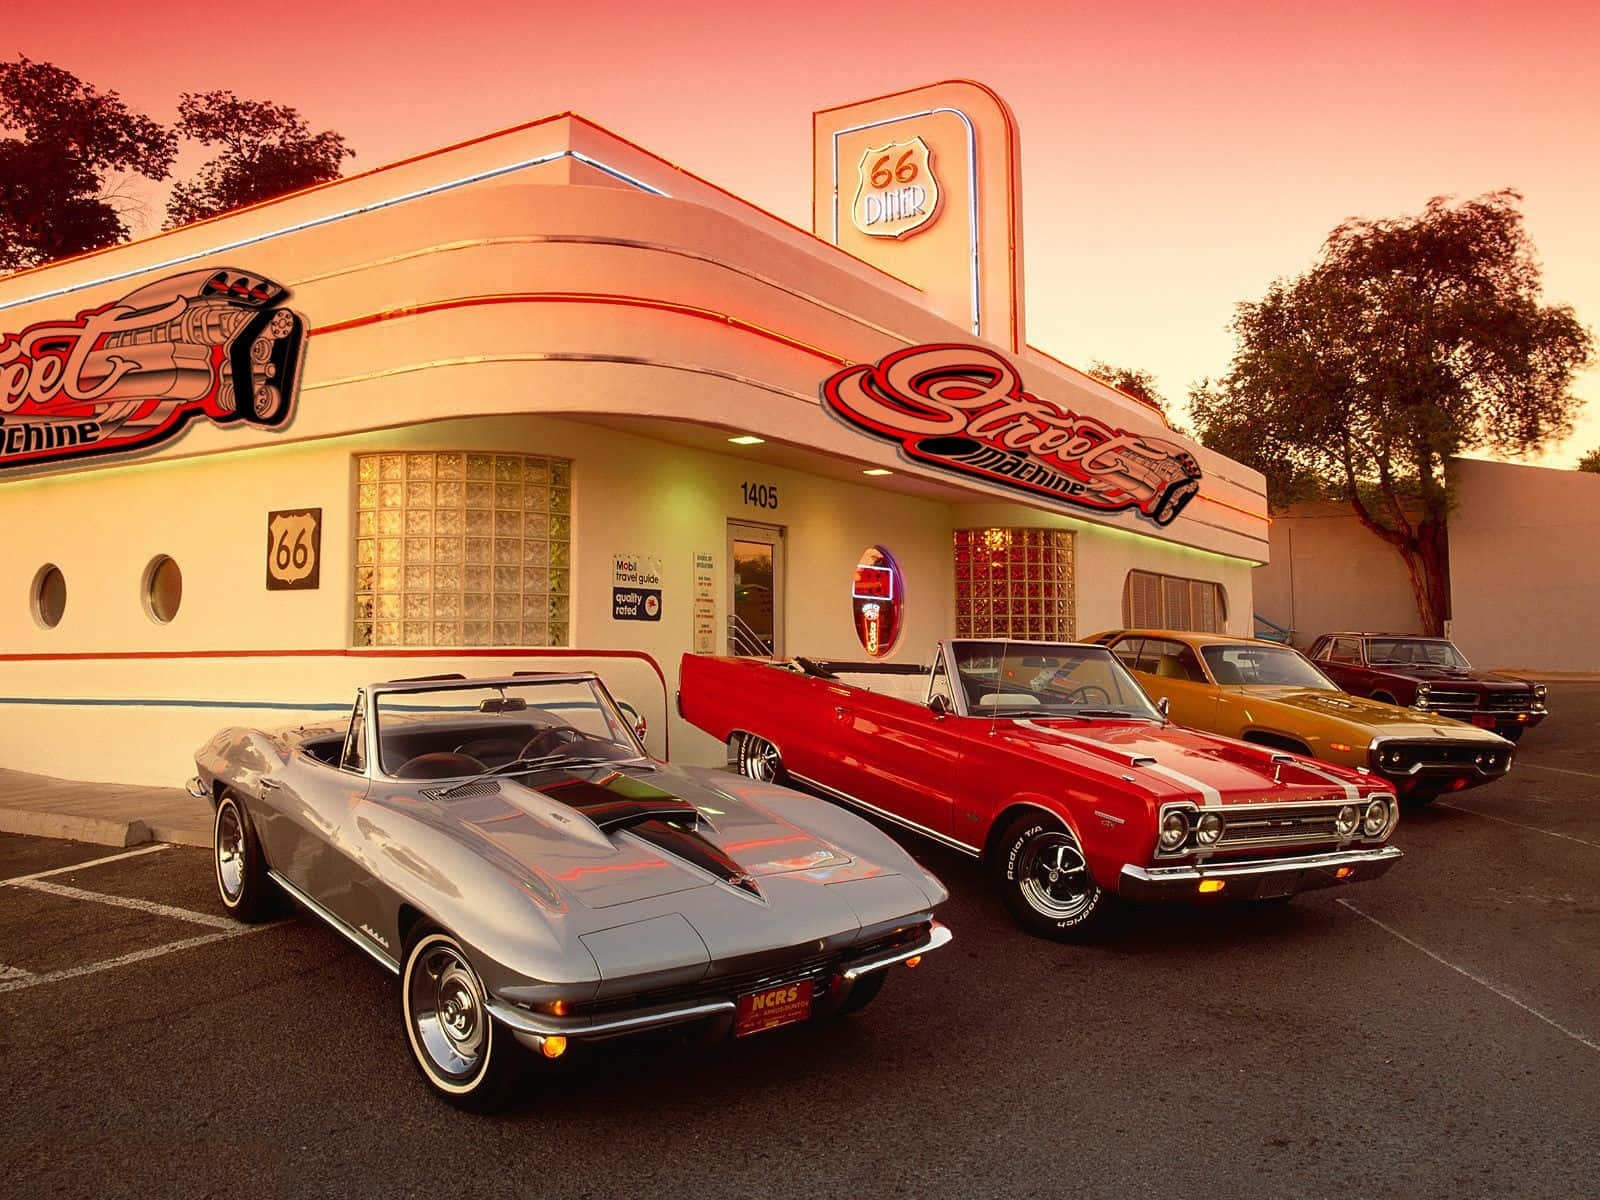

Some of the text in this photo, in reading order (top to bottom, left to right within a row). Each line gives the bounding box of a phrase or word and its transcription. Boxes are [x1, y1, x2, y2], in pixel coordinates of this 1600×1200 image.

[871, 149, 918, 189] 66
[865, 185, 926, 226] DINER
[0, 294, 188, 415] eet
[837, 347, 1167, 475] Street
[945, 445, 1087, 498] machine
[741, 481, 778, 509] 1405
[276, 528, 308, 570] 66
[616, 560, 637, 571] Mobil
[616, 572, 659, 584] travel guide
[615, 593, 642, 605] quality
[615, 605, 637, 616] rated
[1007, 837, 1025, 880] Radial
[752, 987, 798, 1011] NCRS
